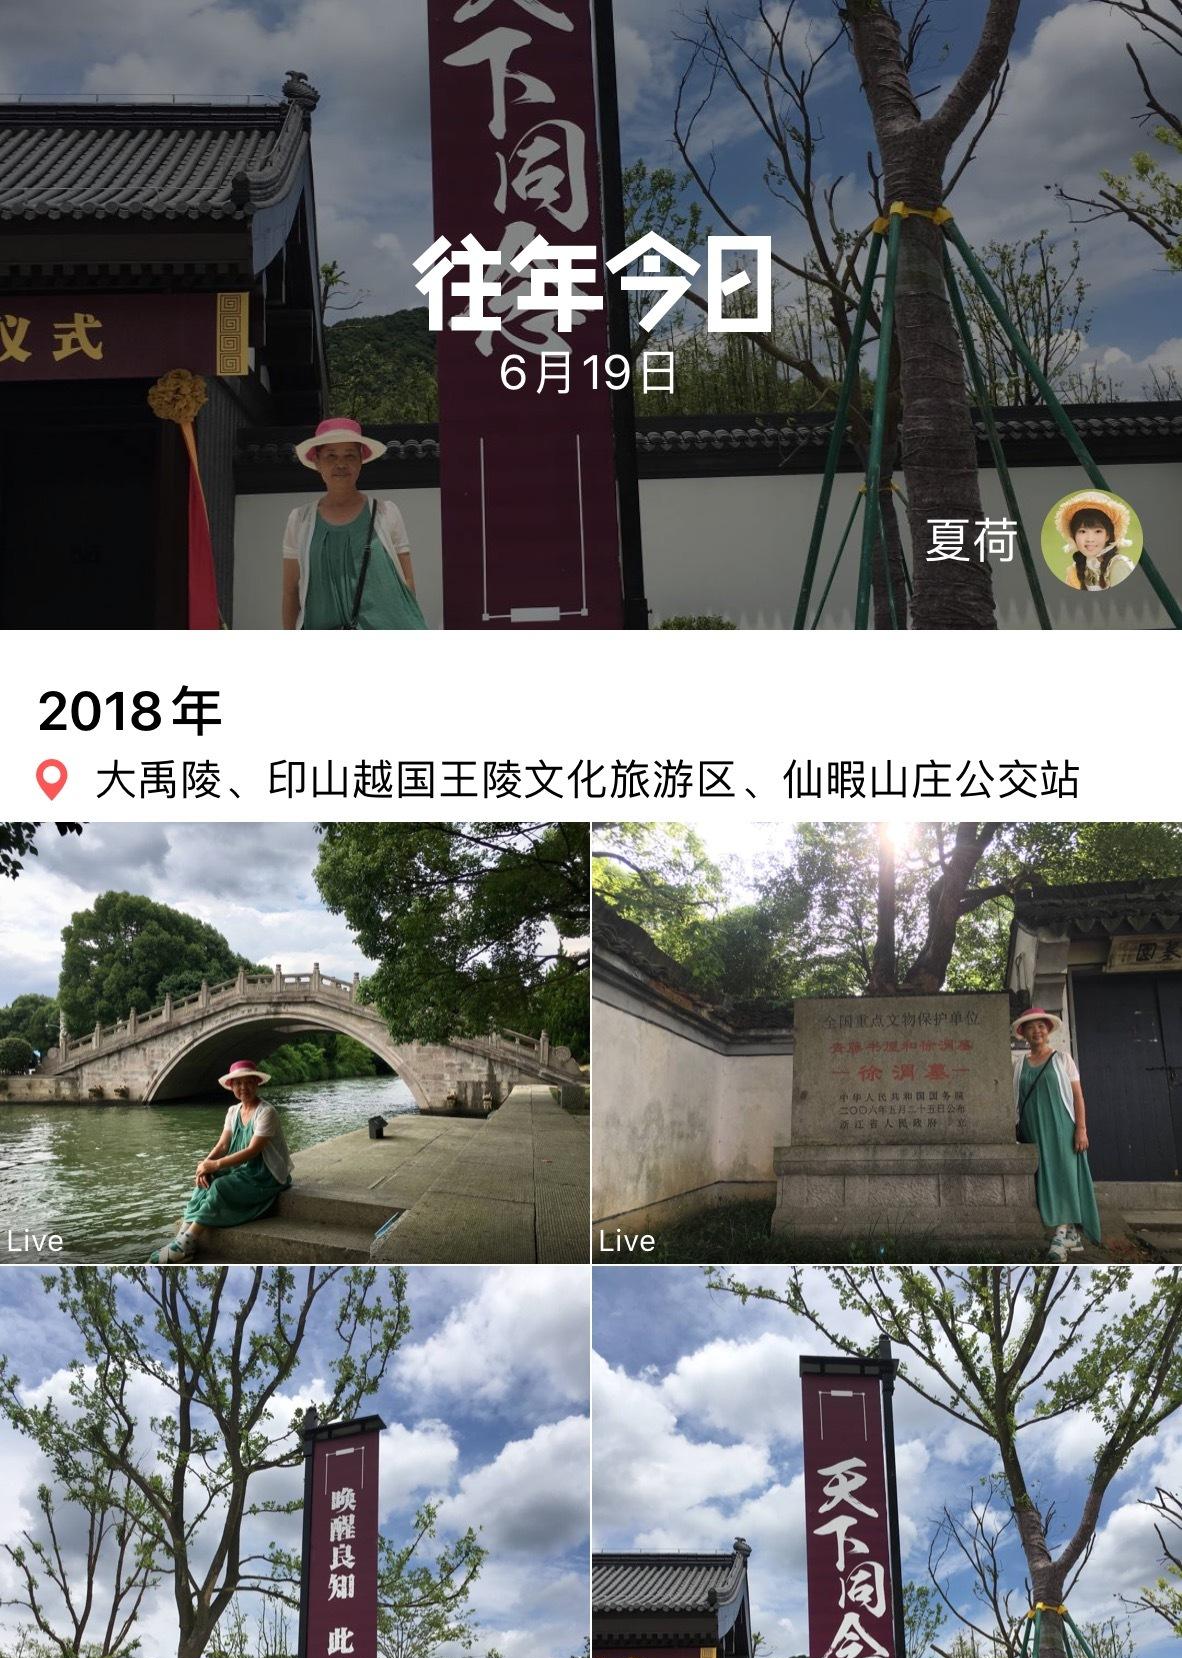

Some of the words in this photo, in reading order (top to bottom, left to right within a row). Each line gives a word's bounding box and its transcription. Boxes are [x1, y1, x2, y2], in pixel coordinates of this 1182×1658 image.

[825, 1010, 981, 1029] 全国重点文物保护单位
[839, 1091, 964, 1104] 中华人民共和国国务院
